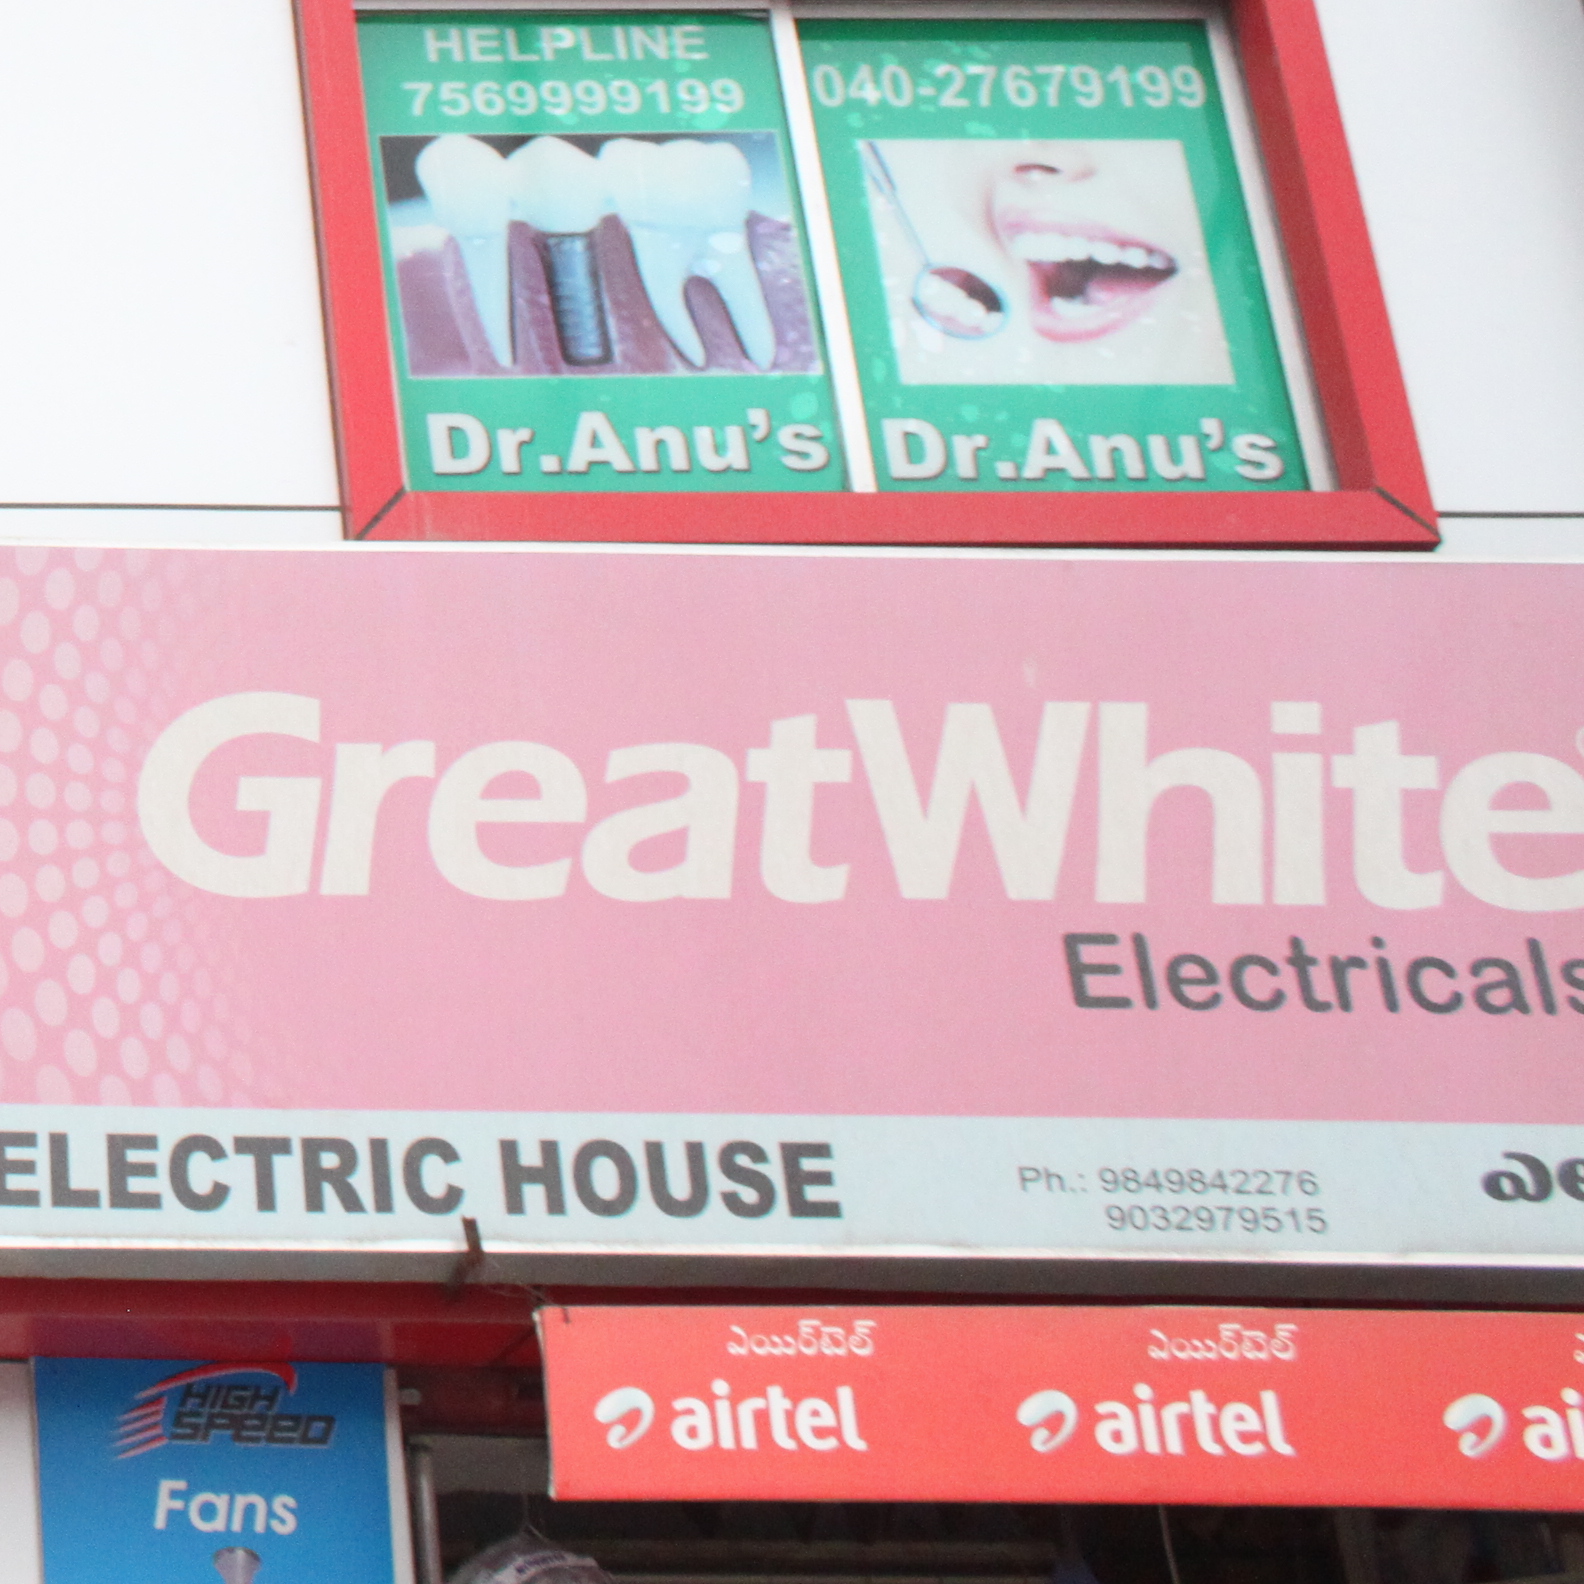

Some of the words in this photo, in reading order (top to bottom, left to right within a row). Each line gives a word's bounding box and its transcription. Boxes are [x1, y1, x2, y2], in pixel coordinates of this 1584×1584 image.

[423, 24, 710, 63] HELPLINE
[400, 77, 746, 117] 7569999199
[811, 62, 1208, 110] 040-27679199
[430, 407, 830, 476] Dr.Anu's
[883, 417, 1286, 482] Dr.Anu's
[137, 692, 1584, 912] GreatWhite
[499, 1137, 844, 1220] HOUSE
[1097, 1166, 1321, 1197] 9849842276
[1105, 1204, 1329, 1235] 9032979515
[180, 1383, 283, 1411] HIGH
[671, 1377, 869, 1452] airtel
[1093, 1382, 1298, 1457] airtel
[153, 1478, 299, 1536] Fans
